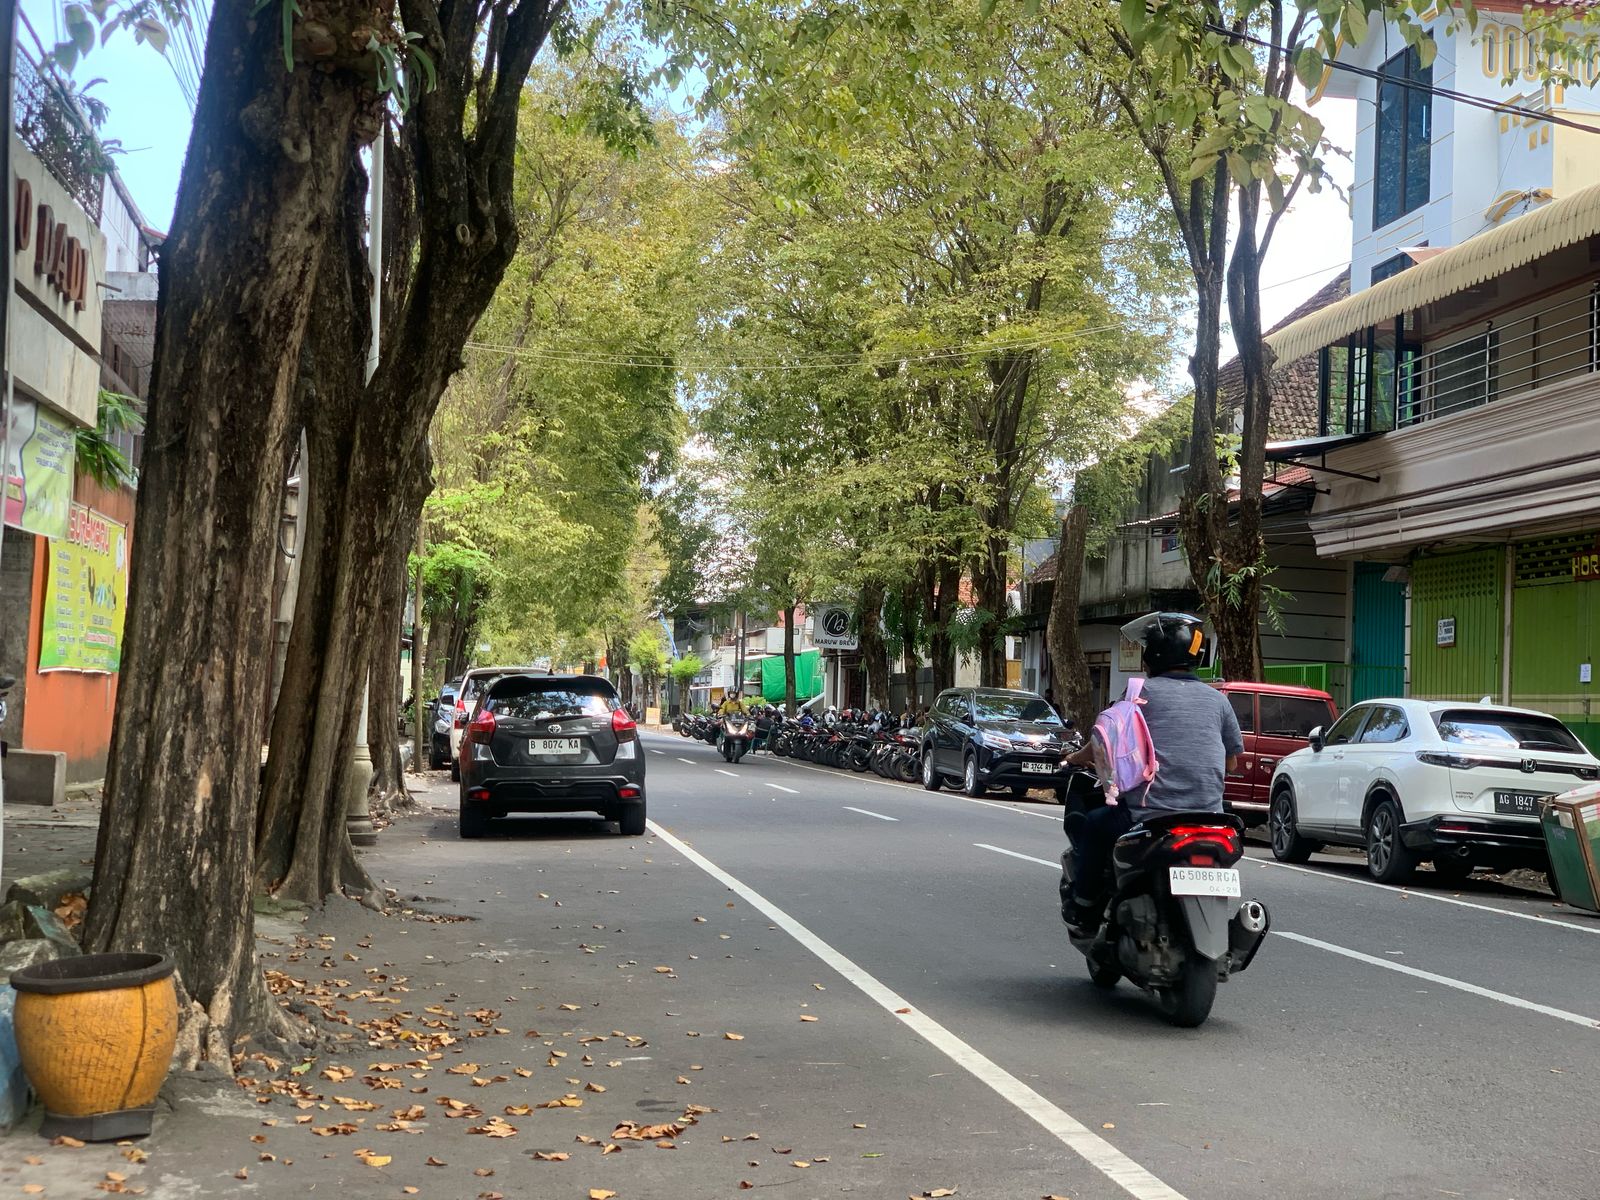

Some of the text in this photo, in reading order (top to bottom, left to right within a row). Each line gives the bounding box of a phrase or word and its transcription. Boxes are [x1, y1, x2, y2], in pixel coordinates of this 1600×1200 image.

[530, 739, 579, 750] B 8074 KA
[1499, 793, 1534, 807] AG 1847
[1172, 870, 1186, 880] AG
[1187, 870, 1215, 881] 5086
